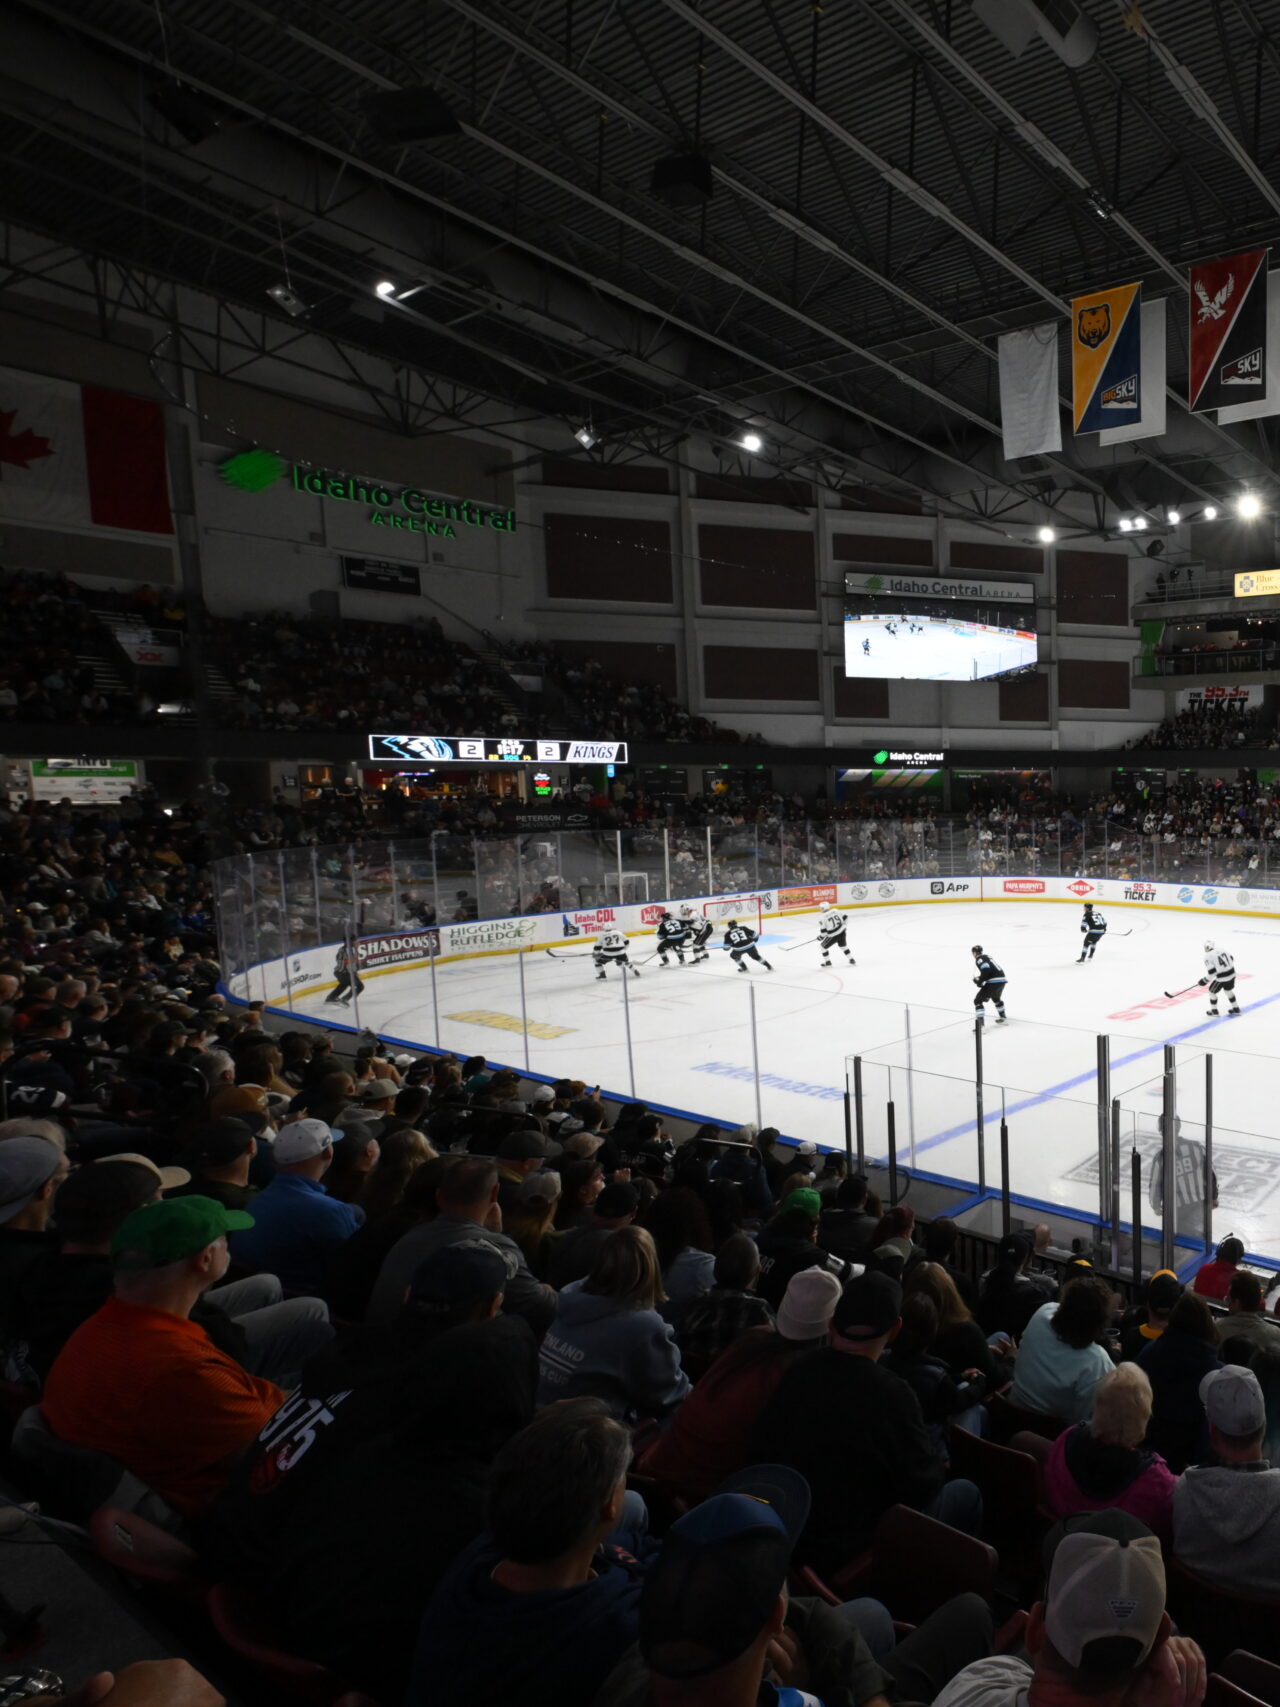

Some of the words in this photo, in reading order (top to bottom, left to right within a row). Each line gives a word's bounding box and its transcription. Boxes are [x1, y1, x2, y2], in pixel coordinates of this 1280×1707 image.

[1237, 352, 1260, 374] SKY
[1116, 377, 1136, 398] SKY
[293, 464, 391, 507] Idaho
[401, 488, 516, 532] Central
[371, 511, 457, 538] ARENA
[890, 579, 929, 593] Idaho
[932, 582, 983, 596] Central
[573, 745, 614, 759] KINGS
[890, 752, 912, 760] Idaho
[1133, 882, 1152, 891] 95.3
[1124, 890, 1156, 901] TICKET
[574, 913, 595, 924] Idaho
[596, 909, 616, 922] CDL
[828, 914, 842, 927] 79
[450, 921, 514, 937] HIGGINS
[666, 920, 681, 933] 53
[450, 929, 525, 946] RUTLEDGE
[605, 935, 620, 947] 27
[730, 930, 747, 943] 93
[1217, 953, 1233, 968] 47
